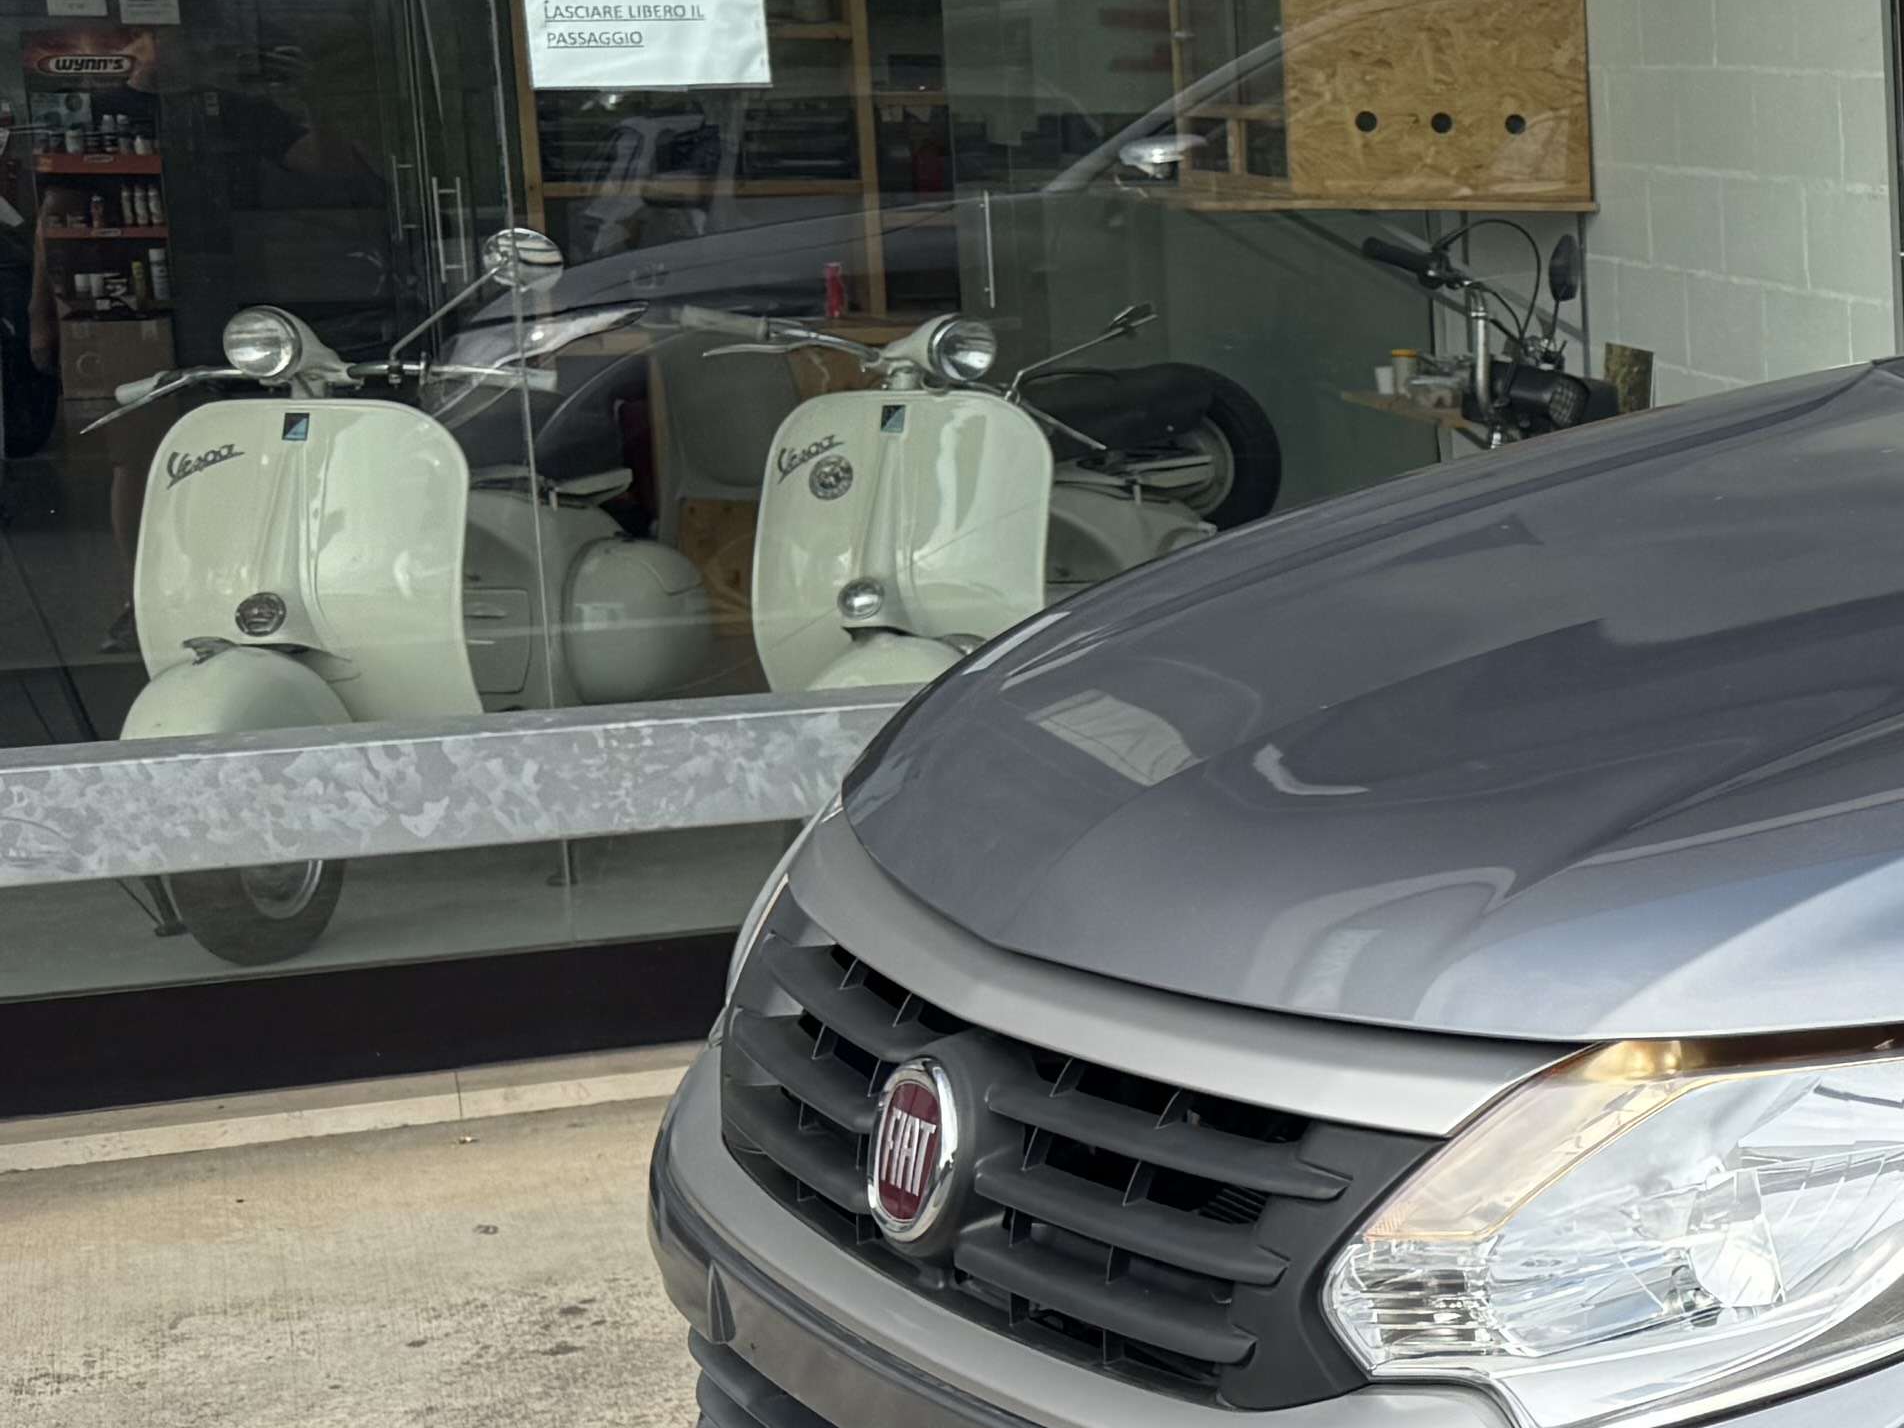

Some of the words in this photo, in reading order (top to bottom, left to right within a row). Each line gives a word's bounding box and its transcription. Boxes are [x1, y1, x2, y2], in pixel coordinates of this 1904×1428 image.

[544, 3, 623, 19] LASCIARE
[628, 4, 686, 18] LIBERO
[691, 4, 705, 18] IL
[547, 31, 643, 45] PASSAGGIO
[880, 1106, 937, 1197] FIAT
